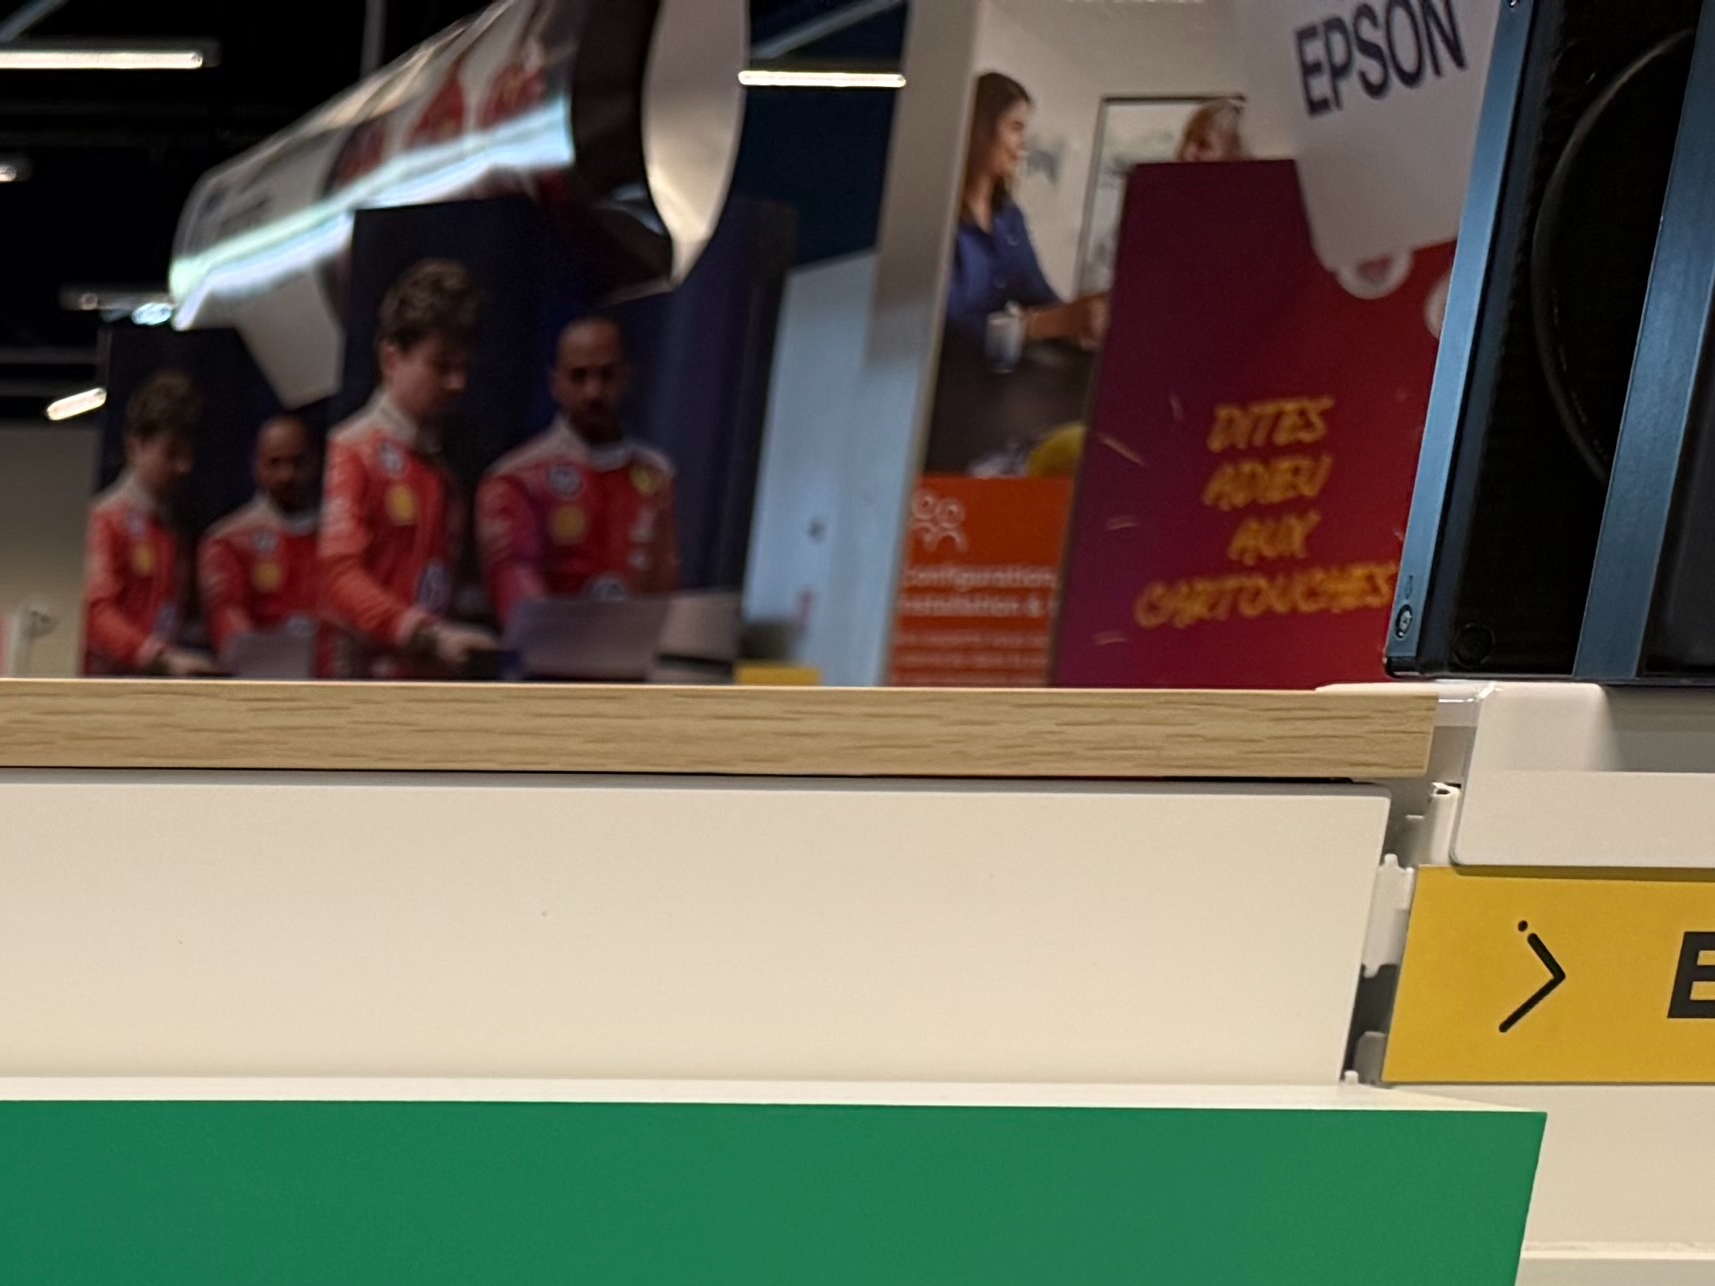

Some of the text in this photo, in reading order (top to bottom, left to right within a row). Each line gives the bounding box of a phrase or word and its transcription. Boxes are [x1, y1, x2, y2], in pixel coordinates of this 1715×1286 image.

[1294, 0, 1468, 118] EPSON
[1206, 396, 1334, 453] DITES
[1203, 453, 1332, 511] ADIEU
[1227, 510, 1321, 566] AUX
[1134, 562, 1399, 629] CARTOUCHES
